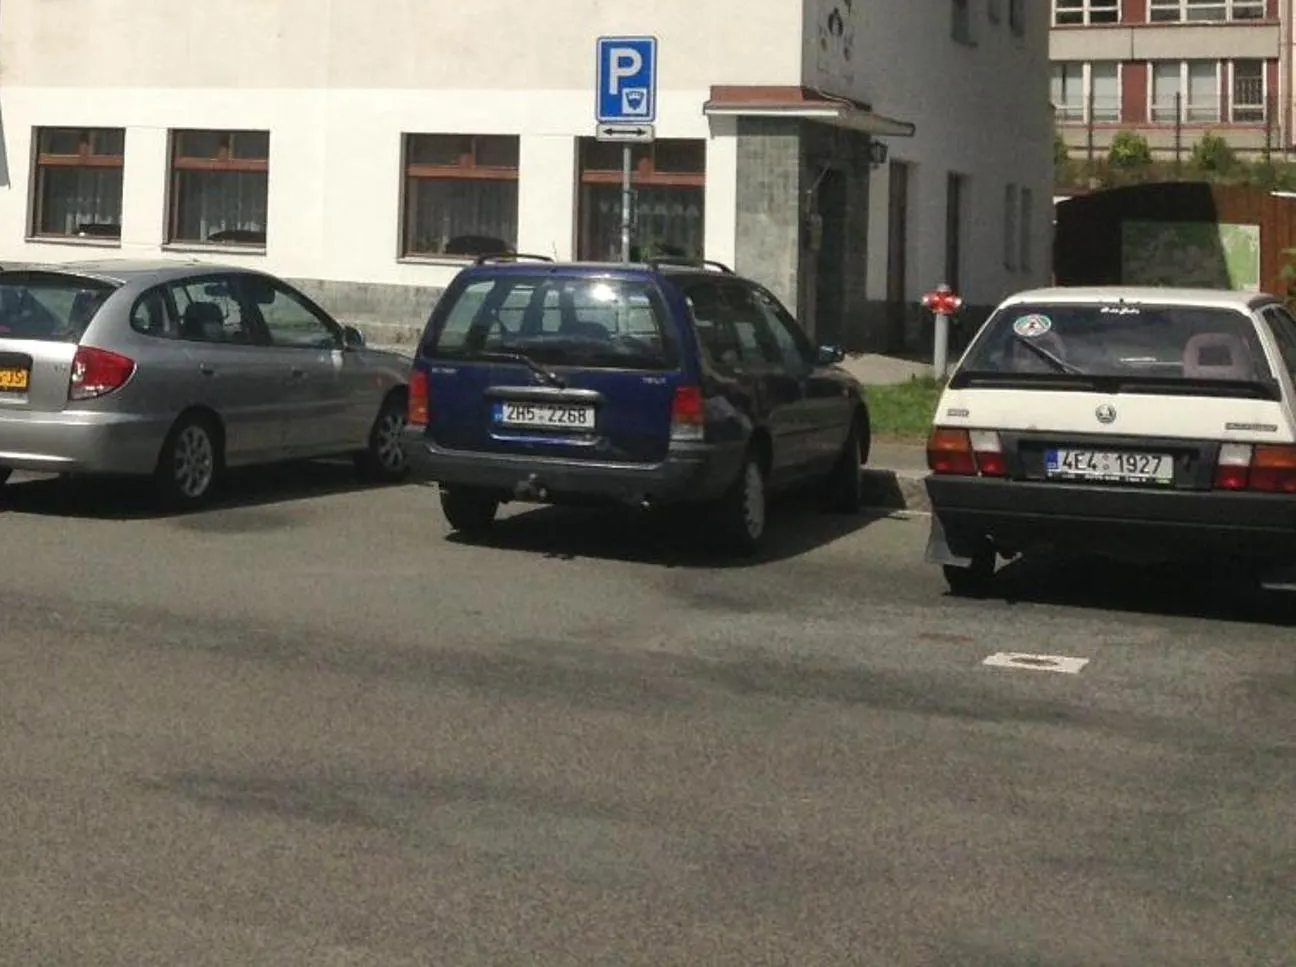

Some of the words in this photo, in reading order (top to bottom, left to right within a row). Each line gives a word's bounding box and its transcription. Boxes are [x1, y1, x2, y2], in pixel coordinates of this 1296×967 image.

[609, 47, 643, 95] P
[507, 404, 536, 421] 2H5
[547, 406, 588, 424] 2268
[1062, 451, 1097, 470] 4E4
[1115, 454, 1163, 474] 1927
